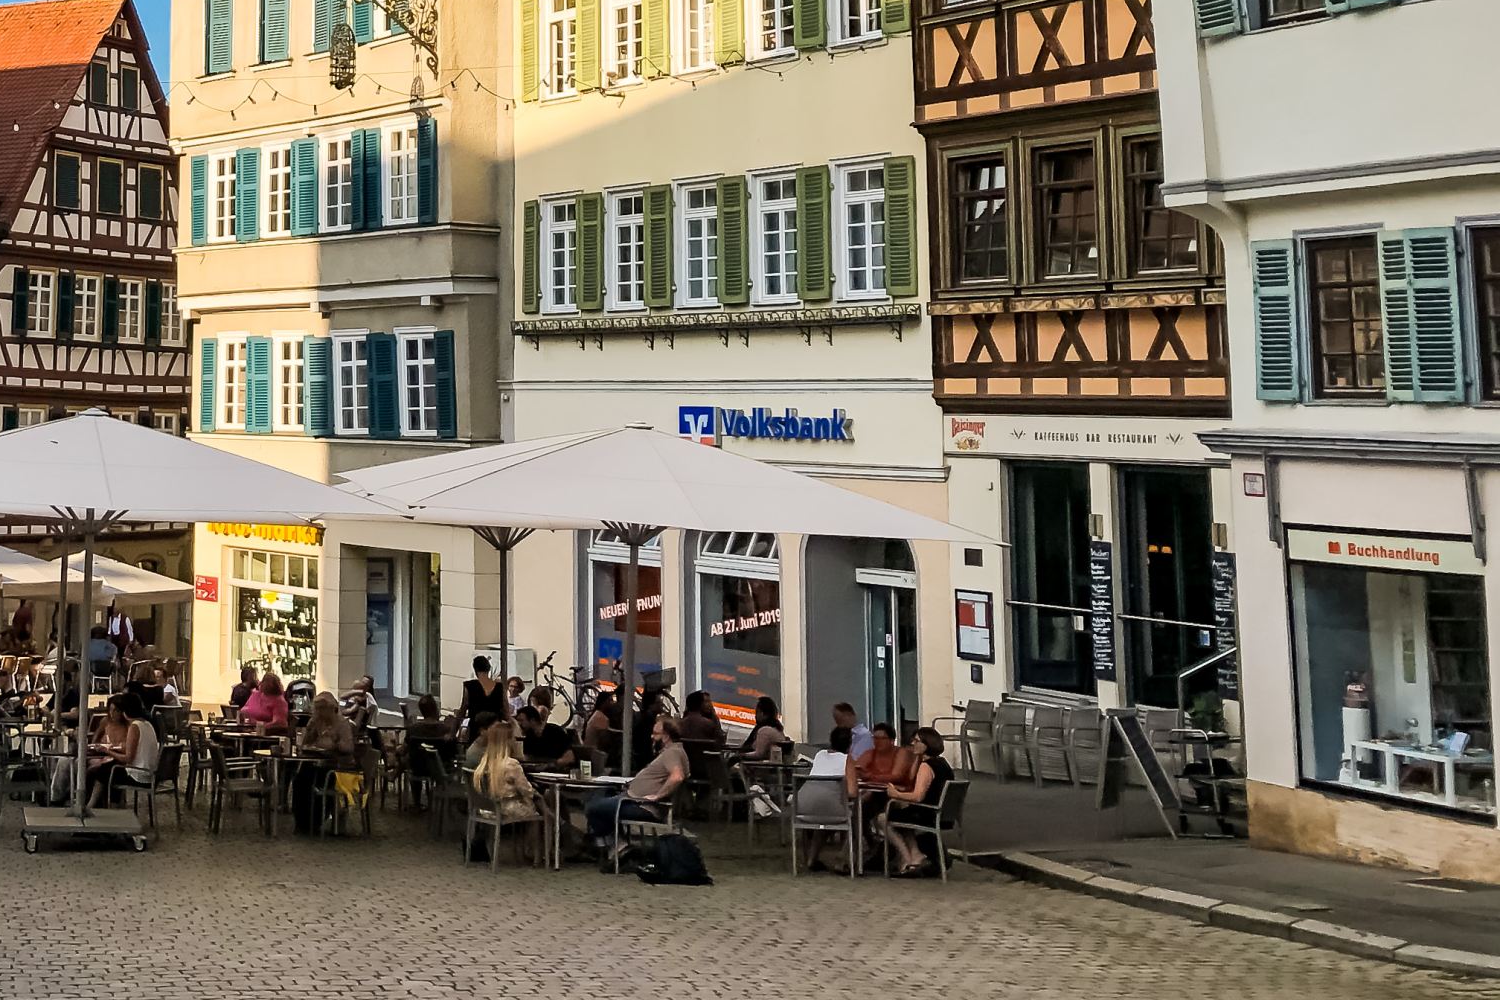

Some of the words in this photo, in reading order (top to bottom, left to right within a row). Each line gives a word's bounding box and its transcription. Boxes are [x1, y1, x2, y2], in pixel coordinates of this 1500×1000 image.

[721, 407, 850, 440] Volksbank
[1034, 431, 1079, 442] KAFFEEHAUS
[1086, 433, 1101, 443] BAR
[1108, 433, 1157, 444] RESTAURANT
[1347, 542, 1440, 566] Buchhandlung
[600, 594, 662, 620] NEUERFNUN
[710, 622, 723, 638] AB
[724, 618, 739, 635] 27.
[740, 612, 758, 630] Juni
[758, 608, 781, 626] 2019
